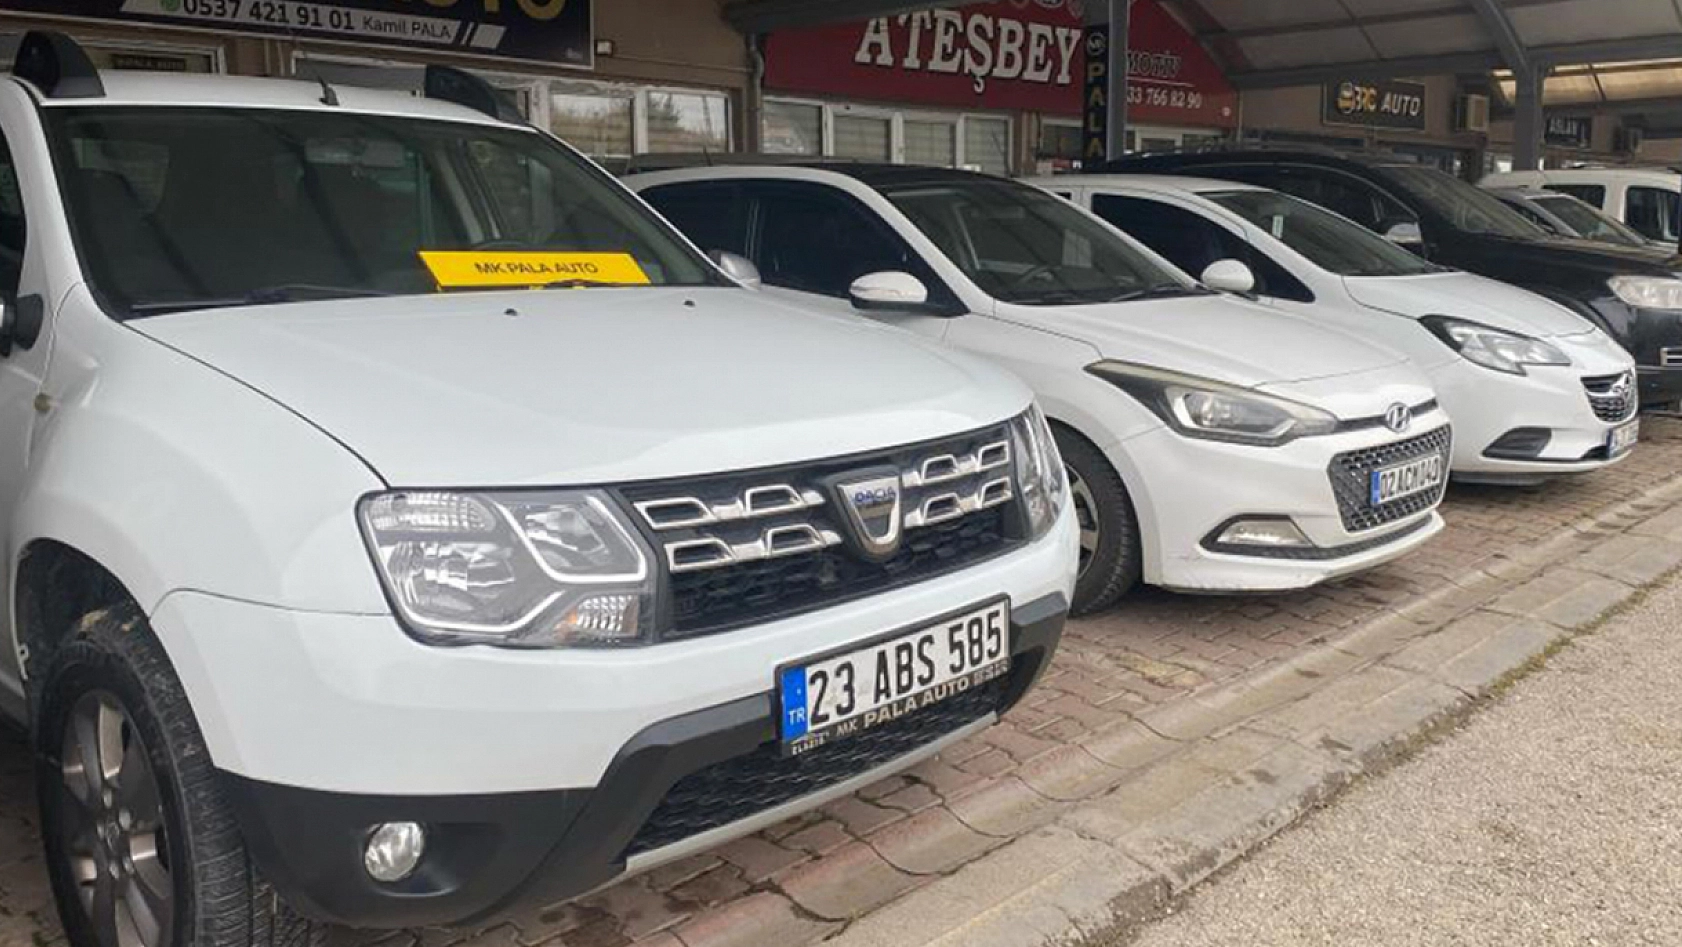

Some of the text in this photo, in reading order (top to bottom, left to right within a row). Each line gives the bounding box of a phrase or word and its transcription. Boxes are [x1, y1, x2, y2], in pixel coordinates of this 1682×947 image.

[183, 0, 451, 38] 0537 421 91 01 Kamil PALA
[855, 9, 1082, 94] ATEŞBEY
[1381, 92, 1421, 117] AUTO
[474, 262, 598, 274] MK PALA AUTO
[809, 660, 855, 726] 23
[873, 634, 935, 705] ABS
[948, 609, 1000, 675] 585
[789, 707, 805, 726] TR
[864, 698, 917, 728] PALA
[922, 676, 969, 708] AUTO
